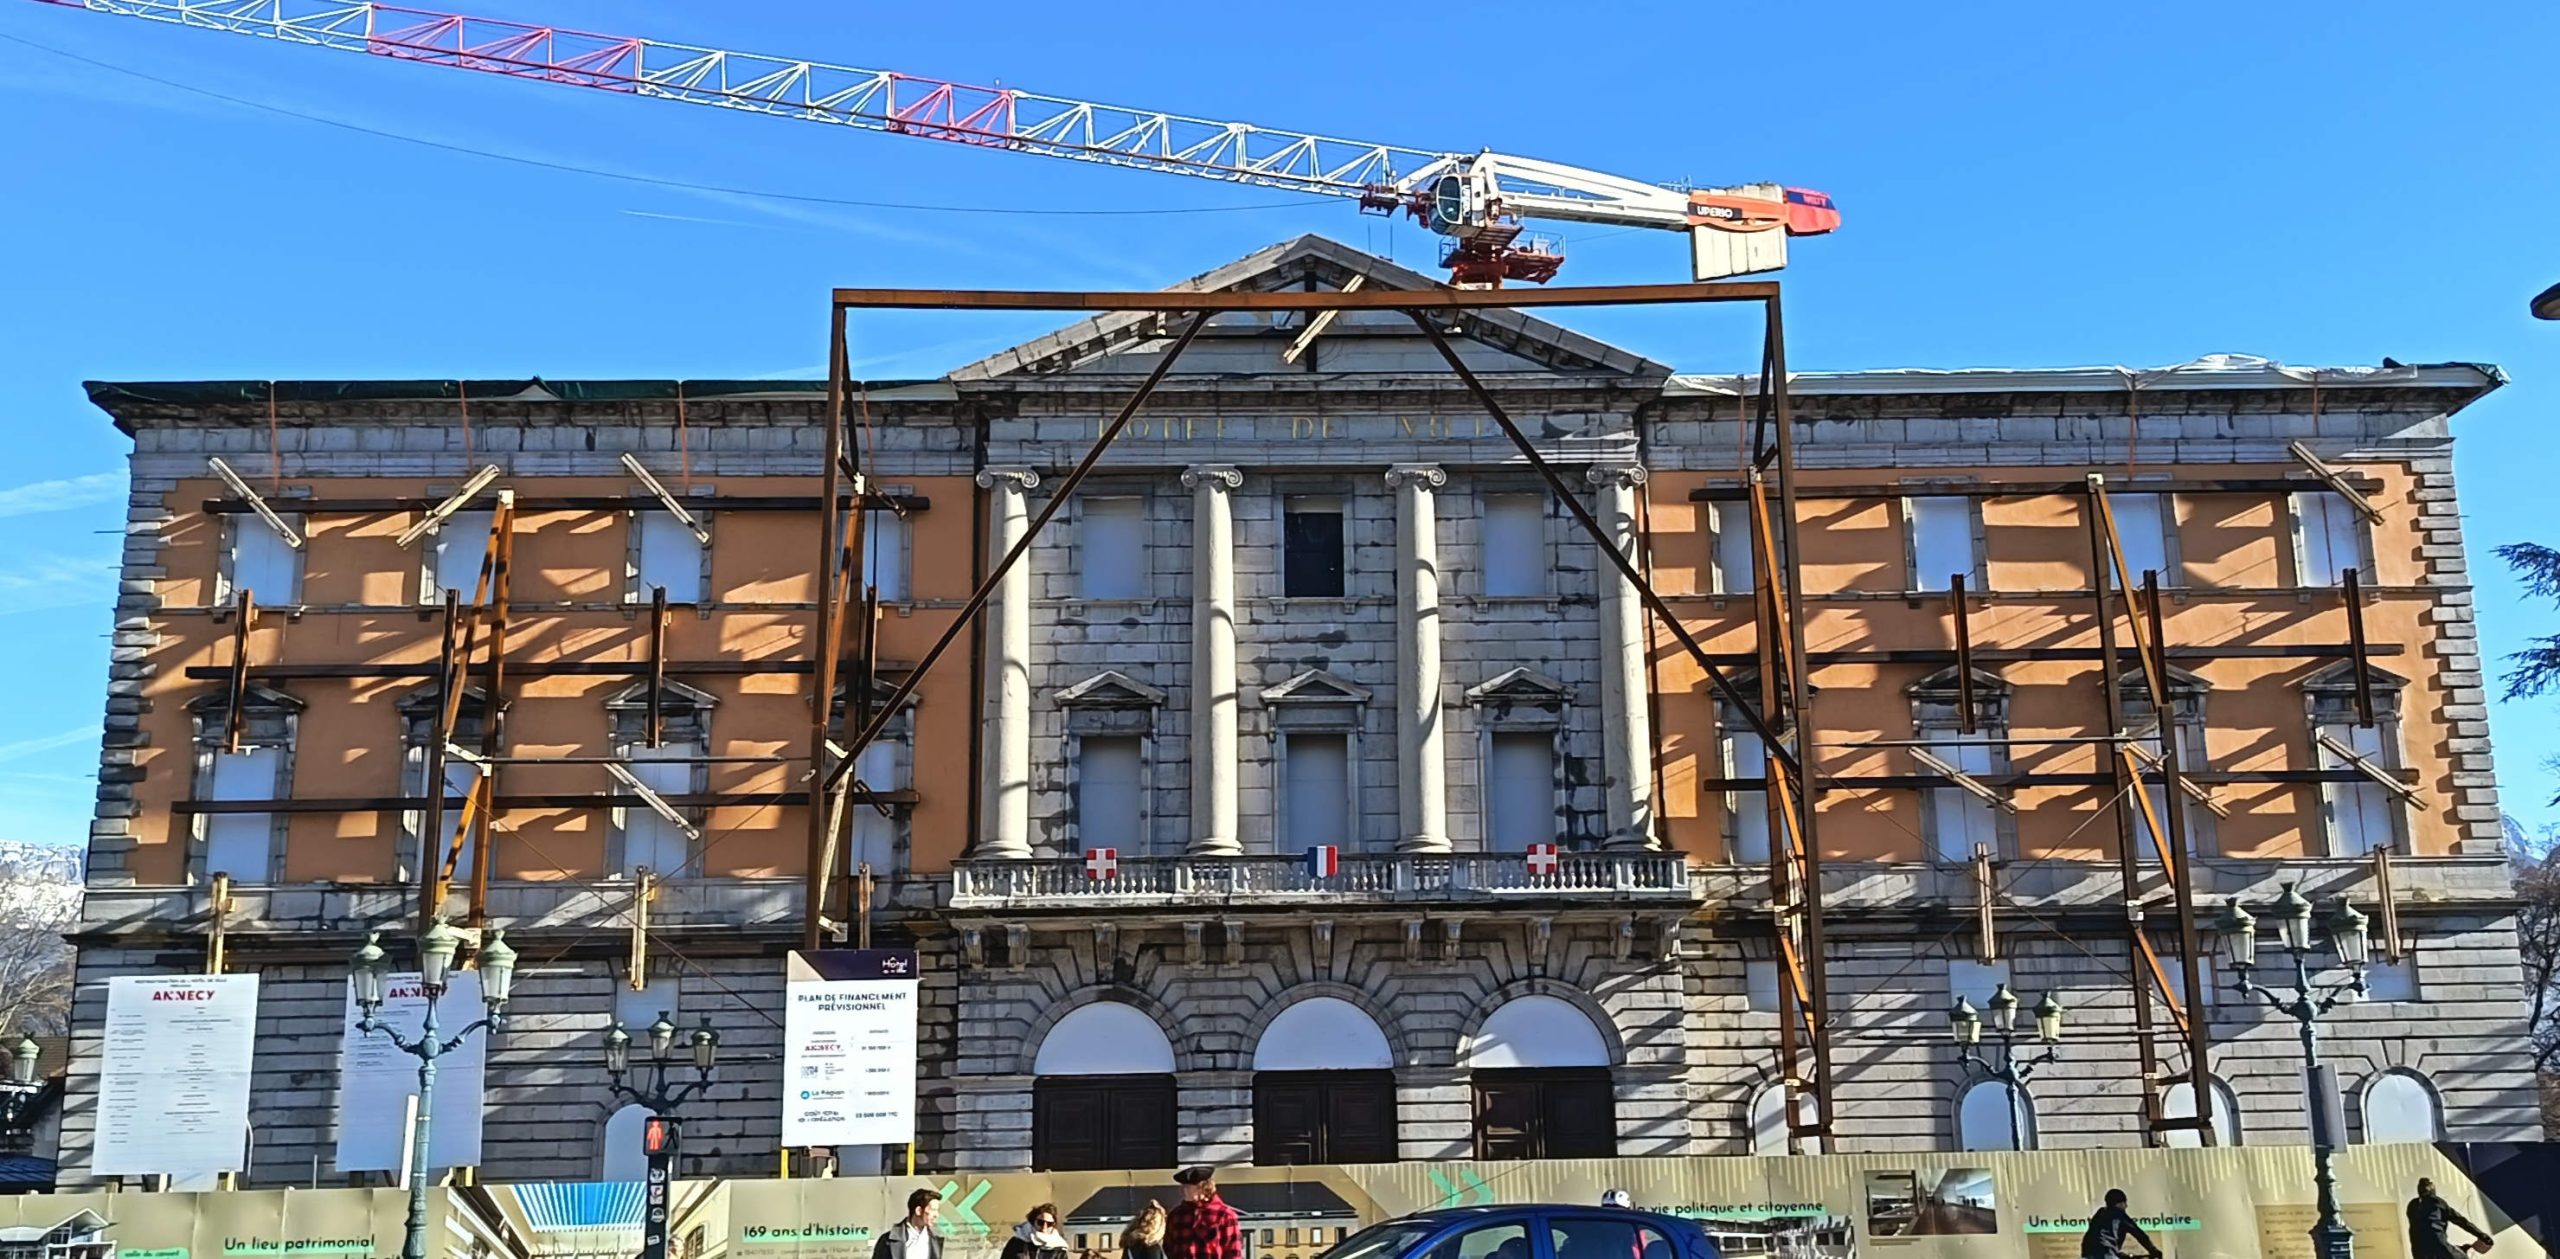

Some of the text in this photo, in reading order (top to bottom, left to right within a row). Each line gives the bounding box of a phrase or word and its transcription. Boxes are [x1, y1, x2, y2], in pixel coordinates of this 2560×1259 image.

[1292, 416, 1336, 438] DE
[152, 990, 215, 1001] ANNECY
[798, 992, 907, 1002] PLAN DE FINANCEMENT
[818, 1001, 886, 1011] PRÉVISIONNEL
[1650, 1203, 1670, 1214] vie
[1675, 1201, 1734, 1216] politique
[1740, 1202, 1752, 1213] et
[1757, 1201, 1823, 1215] citoyenne
[2028, 1215, 2048, 1227] Un
[744, 1222, 869, 1238] 169 ans d'histoire
[224, 1234, 375, 1253] Un lieu patrimonial
